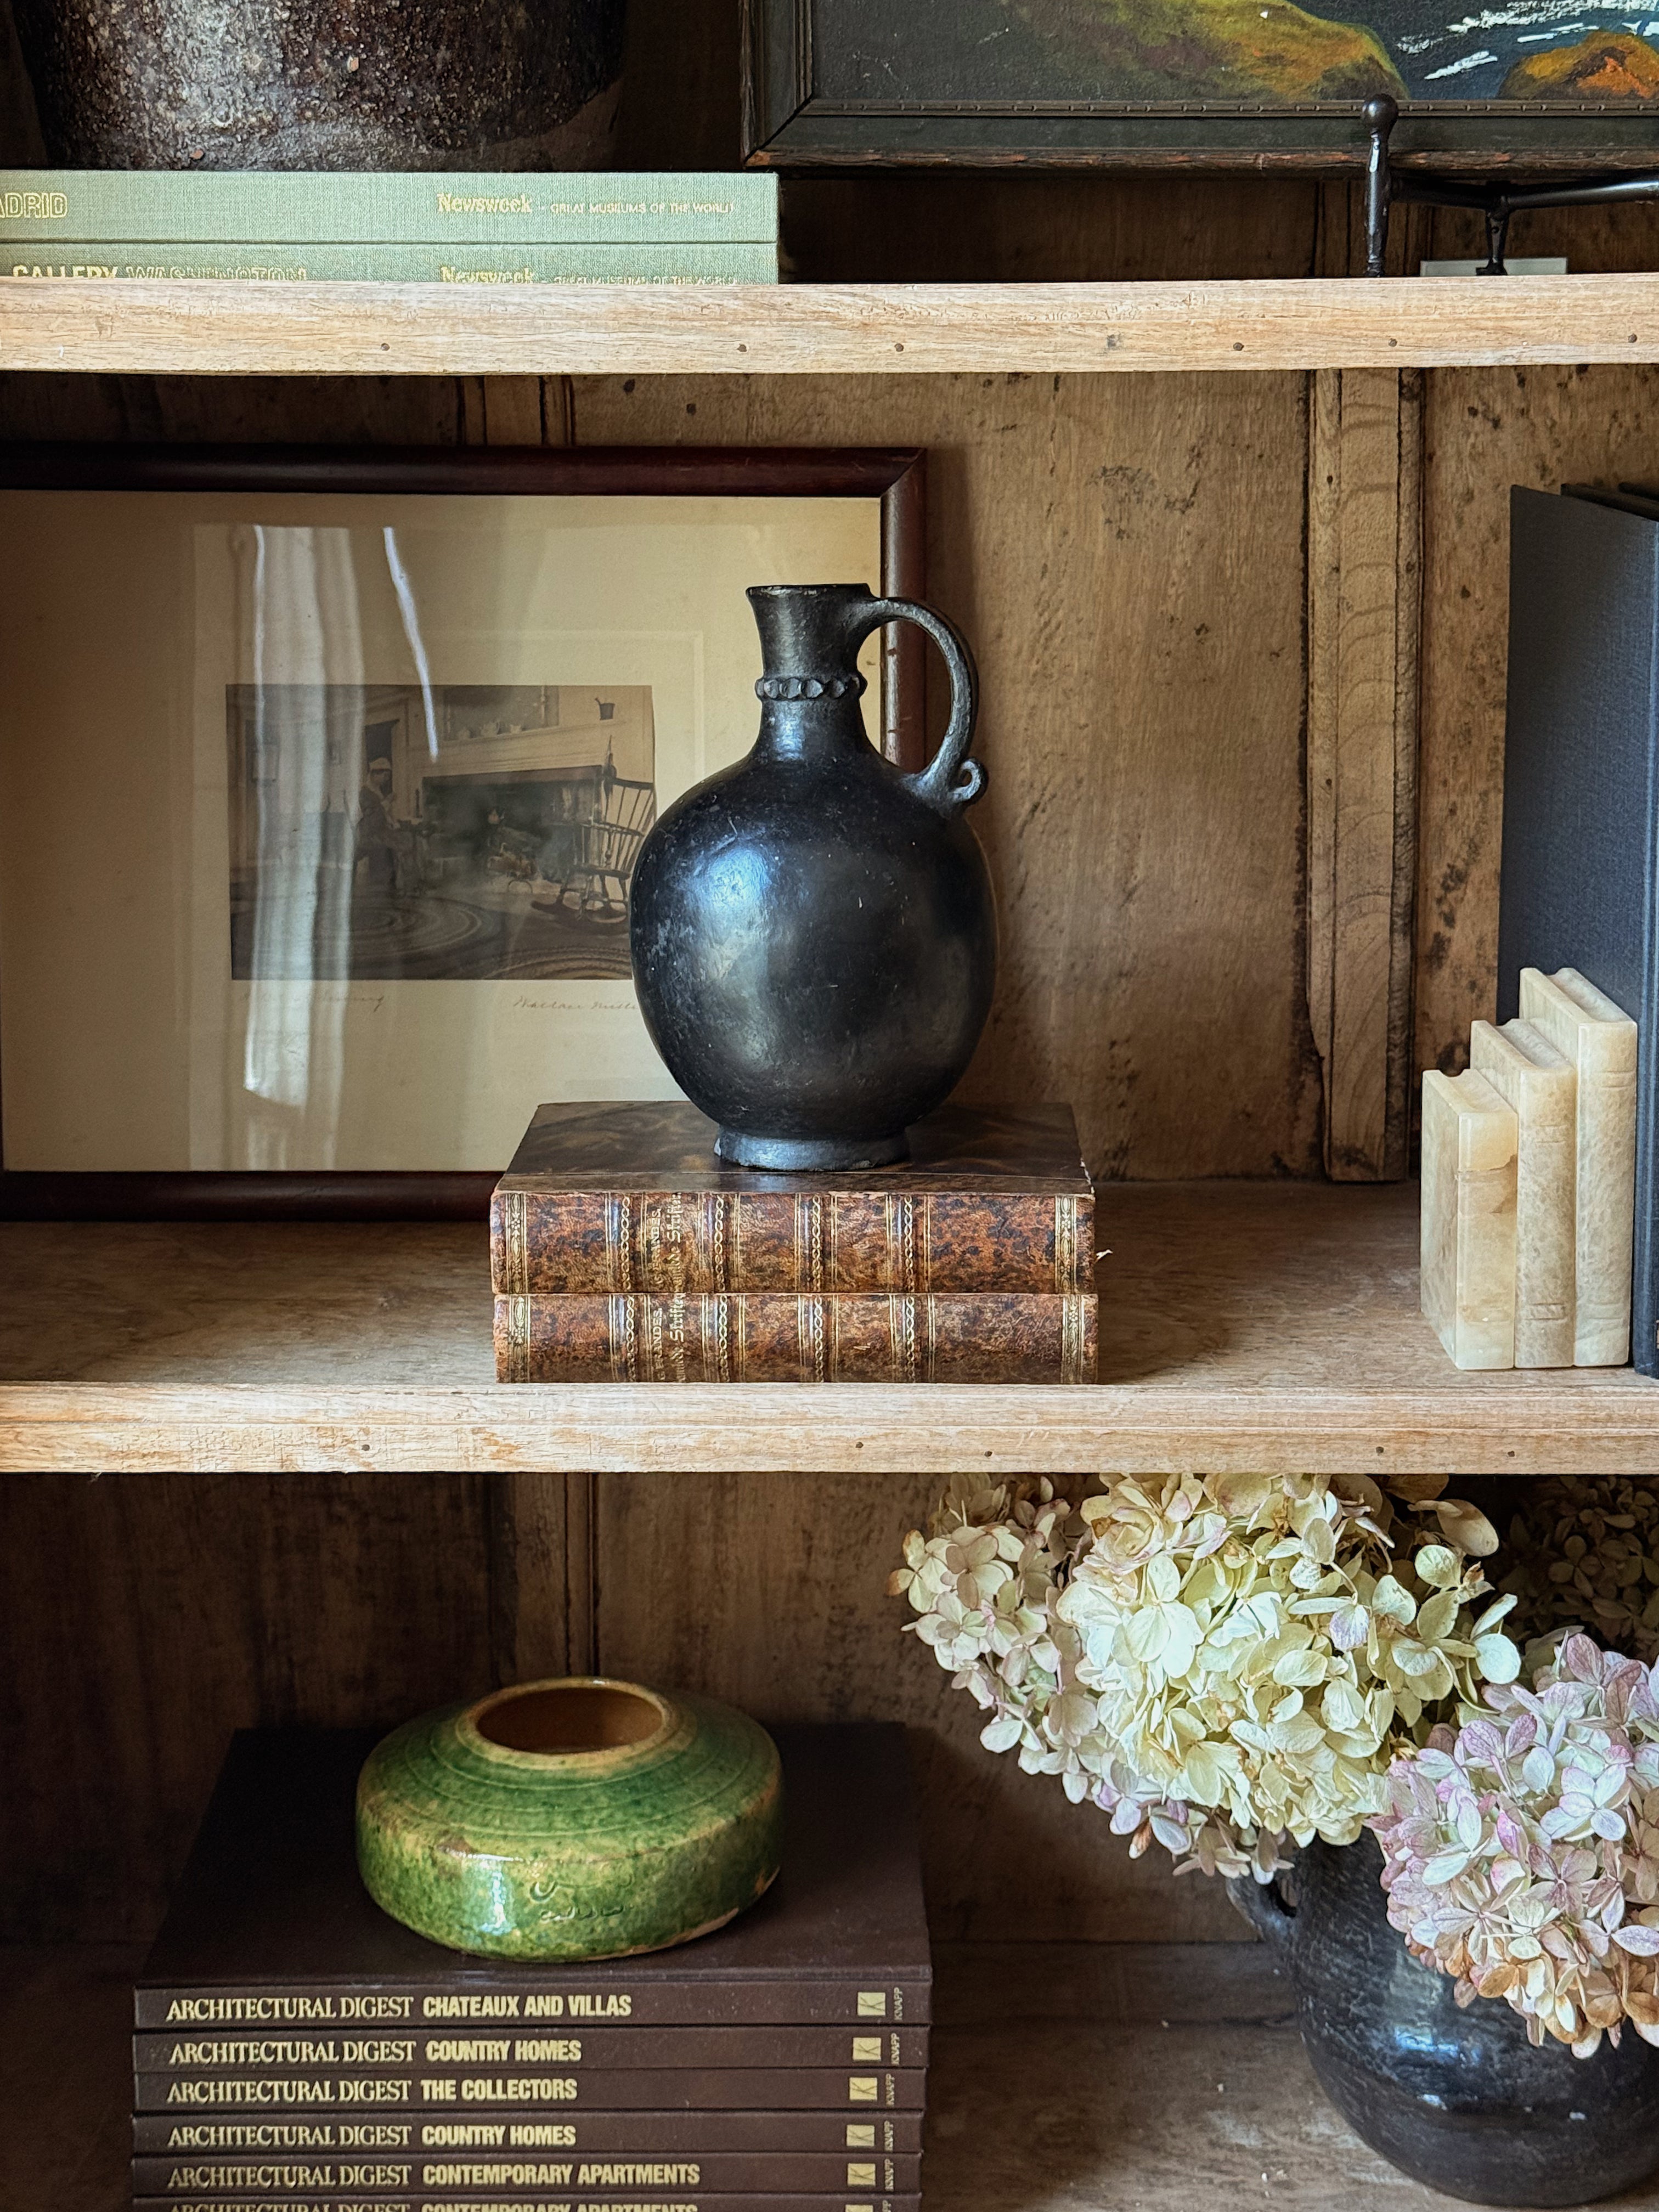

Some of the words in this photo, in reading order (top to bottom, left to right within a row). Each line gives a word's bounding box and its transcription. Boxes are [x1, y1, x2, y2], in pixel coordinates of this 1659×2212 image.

[0, 192, 67, 218] DRID
[437, 193, 532, 213] Newsweek
[550, 202, 584, 213] GREAT
[589, 202, 646, 213] MUSEUMS
[650, 202, 664, 213] OF
[669, 202, 689, 213] THE
[692, 202, 735, 213] WORLD
[166, 1997, 337, 2022] ARCHITECTURAL
[340, 1996, 414, 2019] DIGEST
[423, 1995, 520, 2018] CHATEAUX
[523, 1995, 564, 2017] AND
[567, 1994, 632, 2017] VILLAS
[894, 1987, 903, 2020] KNAPP
[169, 2041, 340, 2064] ARCHITECTURAL
[342, 2040, 417, 2063] DIGEST
[425, 2040, 511, 2062] COUNTRY
[515, 2040, 582, 2062] HOMES
[890, 2033, 900, 2065] KNAPP
[167, 2080, 335, 2103] ARCHITECTURAL
[338, 2080, 412, 2102] DIGEST
[420, 2079, 457, 2101] THE
[461, 2078, 578, 2101] COLLECTORS
[885, 2073, 895, 2107] KNAPP
[168, 2125, 336, 2148] ARCHITECTURAL
[339, 2125, 413, 2147] DIGEST
[421, 2125, 506, 2146] COUNTRY
[510, 2125, 576, 2146] HOMES
[884, 2120, 893, 2152] KNAPP
[168, 2165, 336, 2188] ARCHITECTURAL
[339, 2165, 412, 2187] DIGEST
[423, 2164, 573, 2186] CONTEMPORARY
[577, 2164, 700, 2185] APARTMENTS
[884, 2158, 894, 2191] KNAPP
